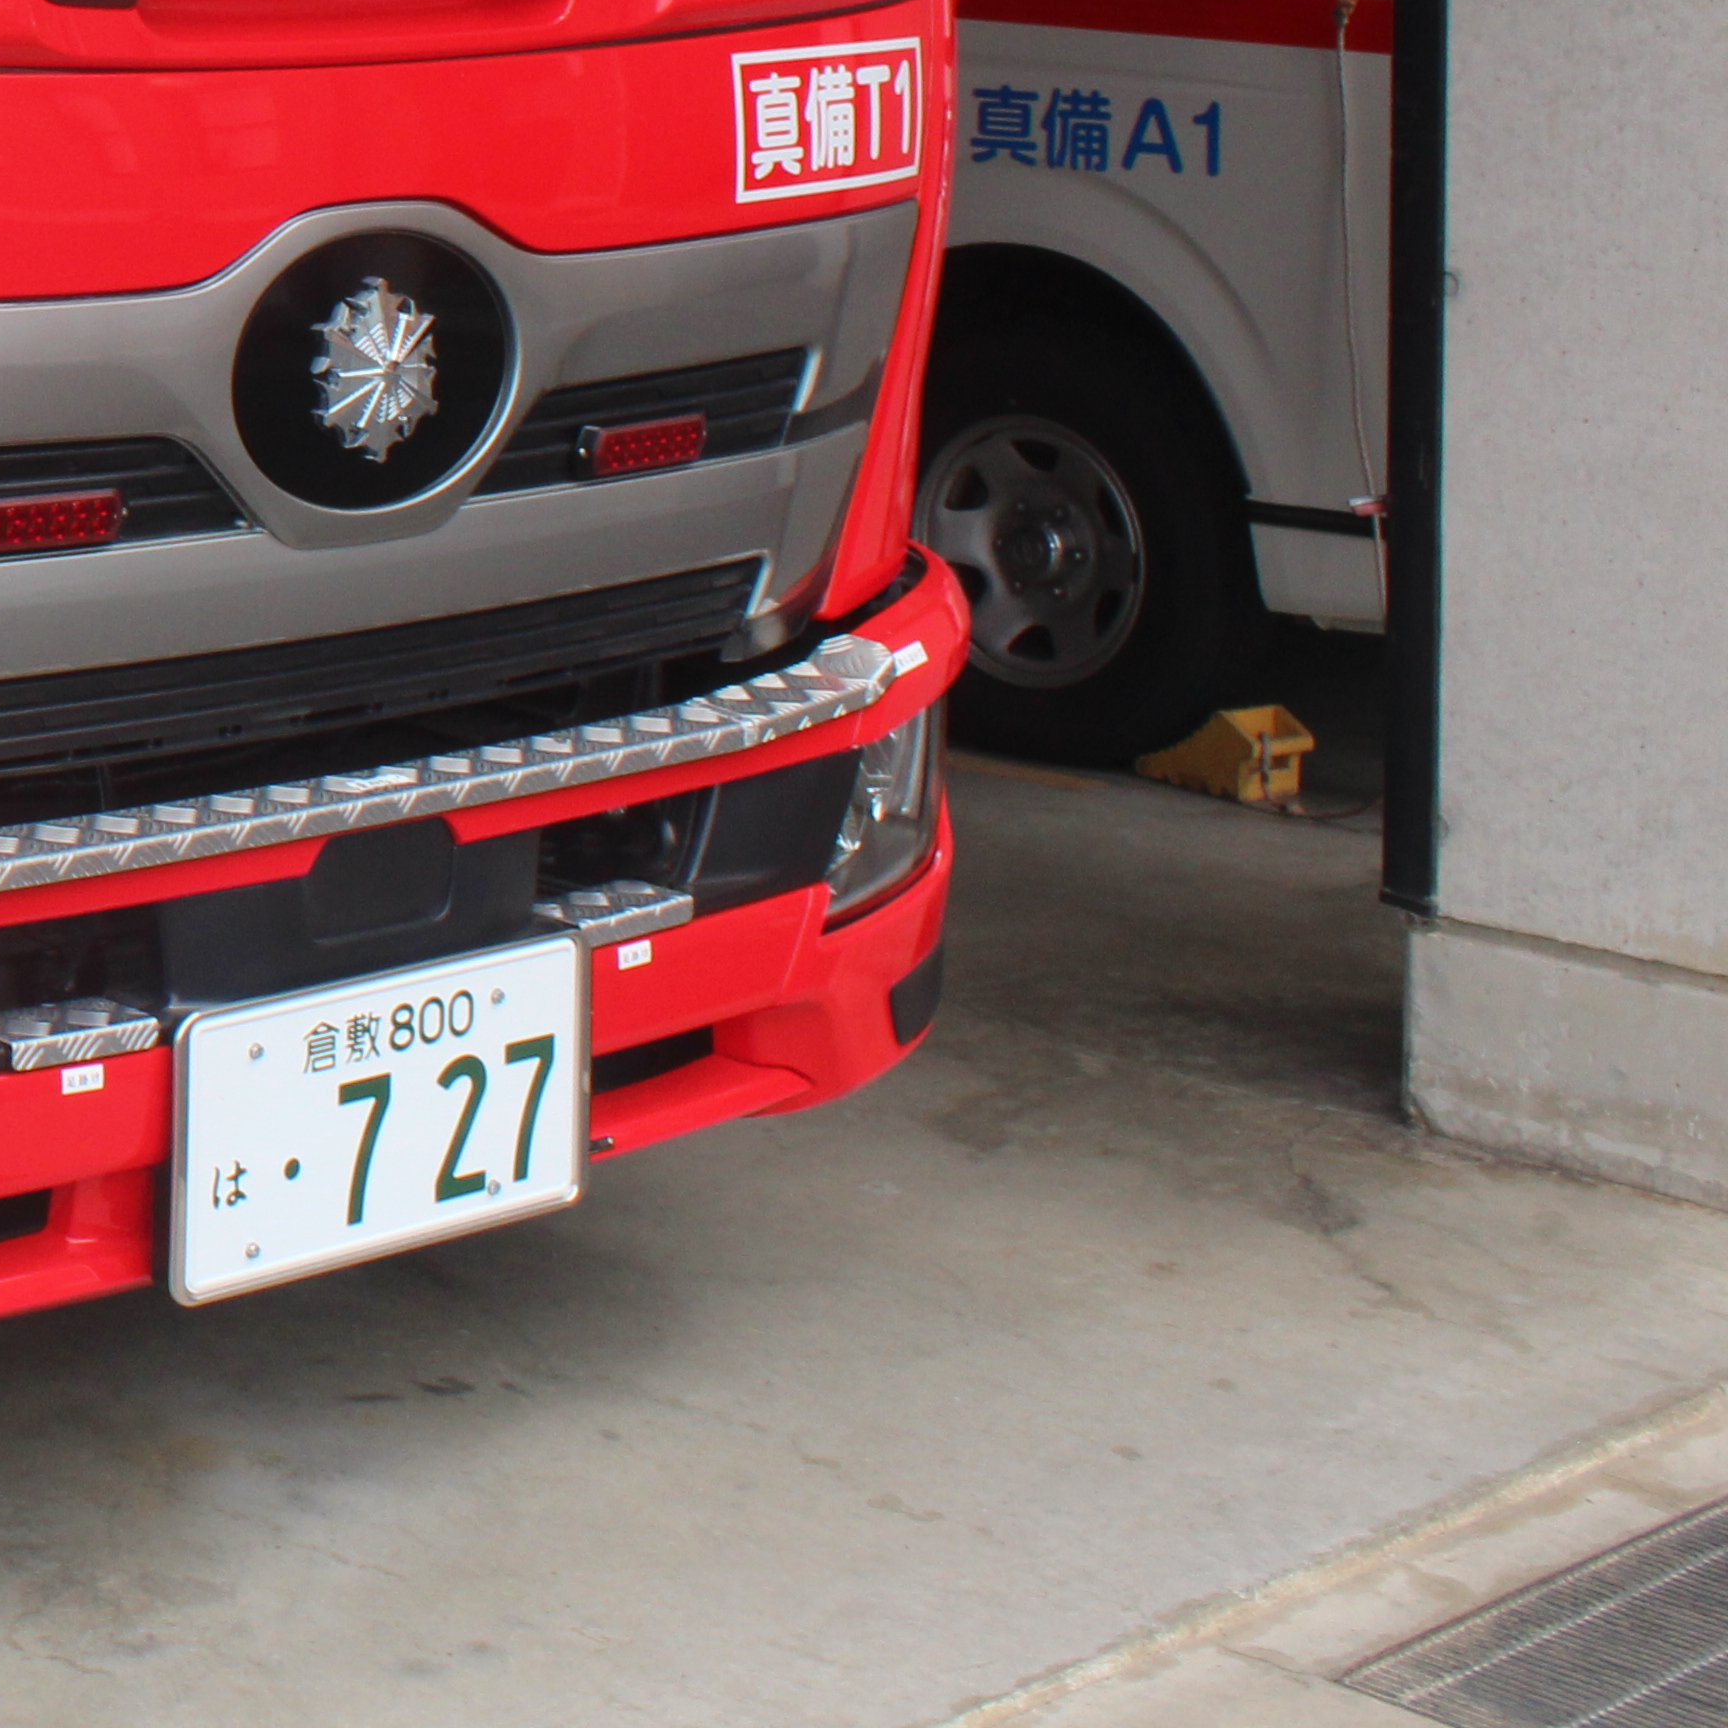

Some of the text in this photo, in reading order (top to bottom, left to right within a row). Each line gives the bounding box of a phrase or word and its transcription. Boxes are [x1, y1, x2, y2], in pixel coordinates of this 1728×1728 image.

[749, 59, 912, 181] 真備T1
[970, 84, 1223, 177] 真備A1
[212, 1160, 249, 1210] は
